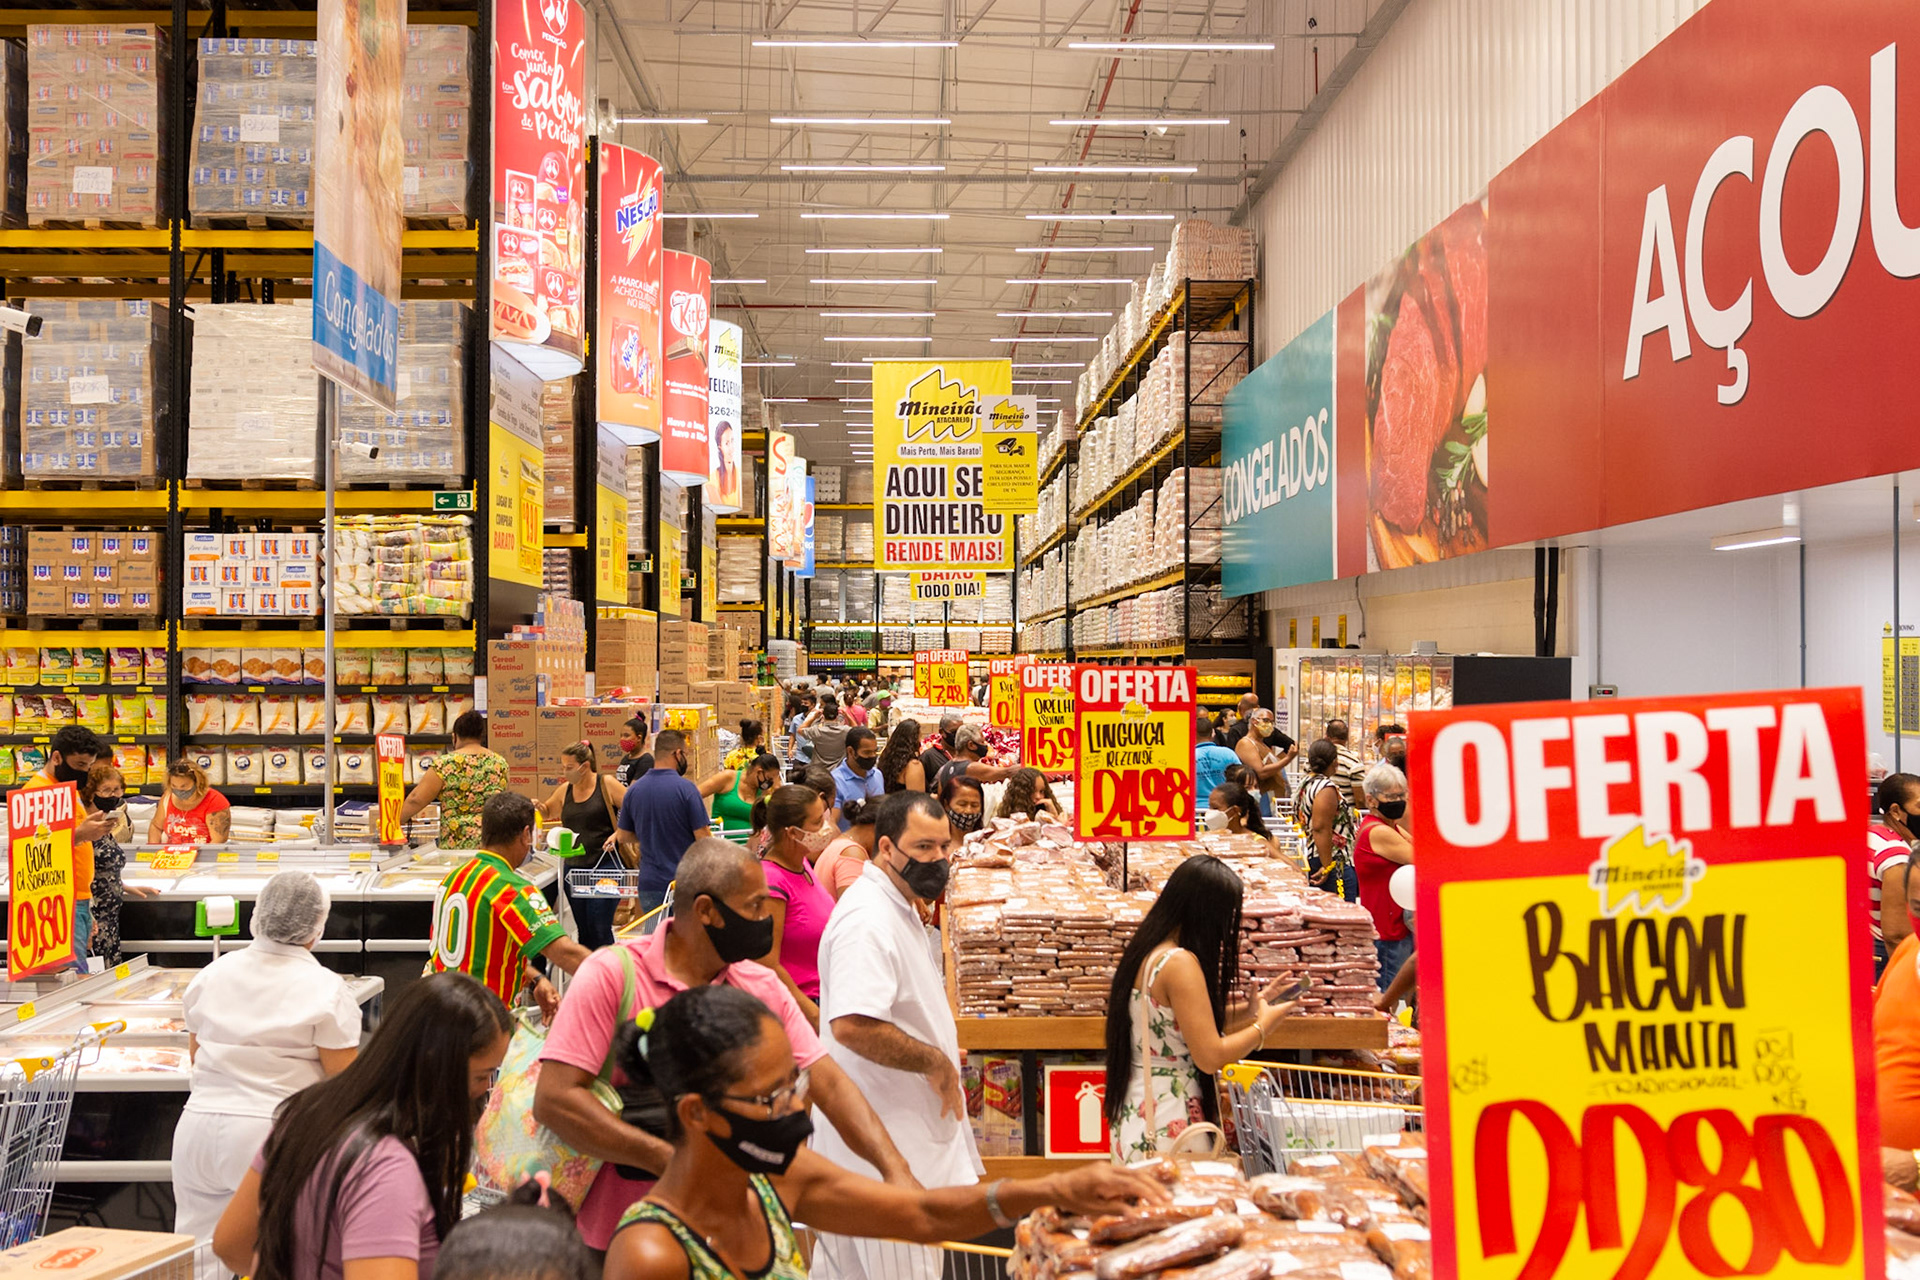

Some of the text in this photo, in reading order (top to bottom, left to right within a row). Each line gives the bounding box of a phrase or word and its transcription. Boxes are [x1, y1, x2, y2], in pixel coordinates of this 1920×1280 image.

[325, 270, 394, 365] Congelados
[989, 412, 1030, 420] Mineirão
[900, 446, 982, 457] Mais Perto, Mais Barato!
[1223, 407, 1329, 525] CONGELADOS
[886, 467, 946, 497] AQUI
[886, 504, 1000, 535] DINHEIRO
[494, 531, 515, 551] BARATO
[886, 541, 1002, 562] RENDE MAIS!
[917, 582, 980, 598] TODO DIA!
[494, 663, 524, 671] Matinal
[930, 650, 967, 662] OFERTA
[991, 660, 1013, 674] OFE
[1023, 665, 1075, 687] OFER
[1081, 669, 1190, 703] OFERTA
[933, 685, 964, 703] 7,48
[1034, 698, 1075, 714] ORELH
[583, 721, 607, 729] Cereal
[586, 729, 616, 737] Matinal
[379, 736, 404, 758] OFERTA
[1026, 727, 1075, 768] 15,9
[1107, 751, 1154, 767] REZENDE
[1431, 703, 1847, 847] OFERTA
[11, 786, 73, 830] OFERTA
[25, 843, 52, 874] COXA
[1595, 862, 1701, 886] Mineirão
[11, 894, 67, 970] 9,80
[528, 921, 541, 934] São
[1523, 901, 1747, 1022] BACON
[1584, 1020, 1739, 1075] MANTA
